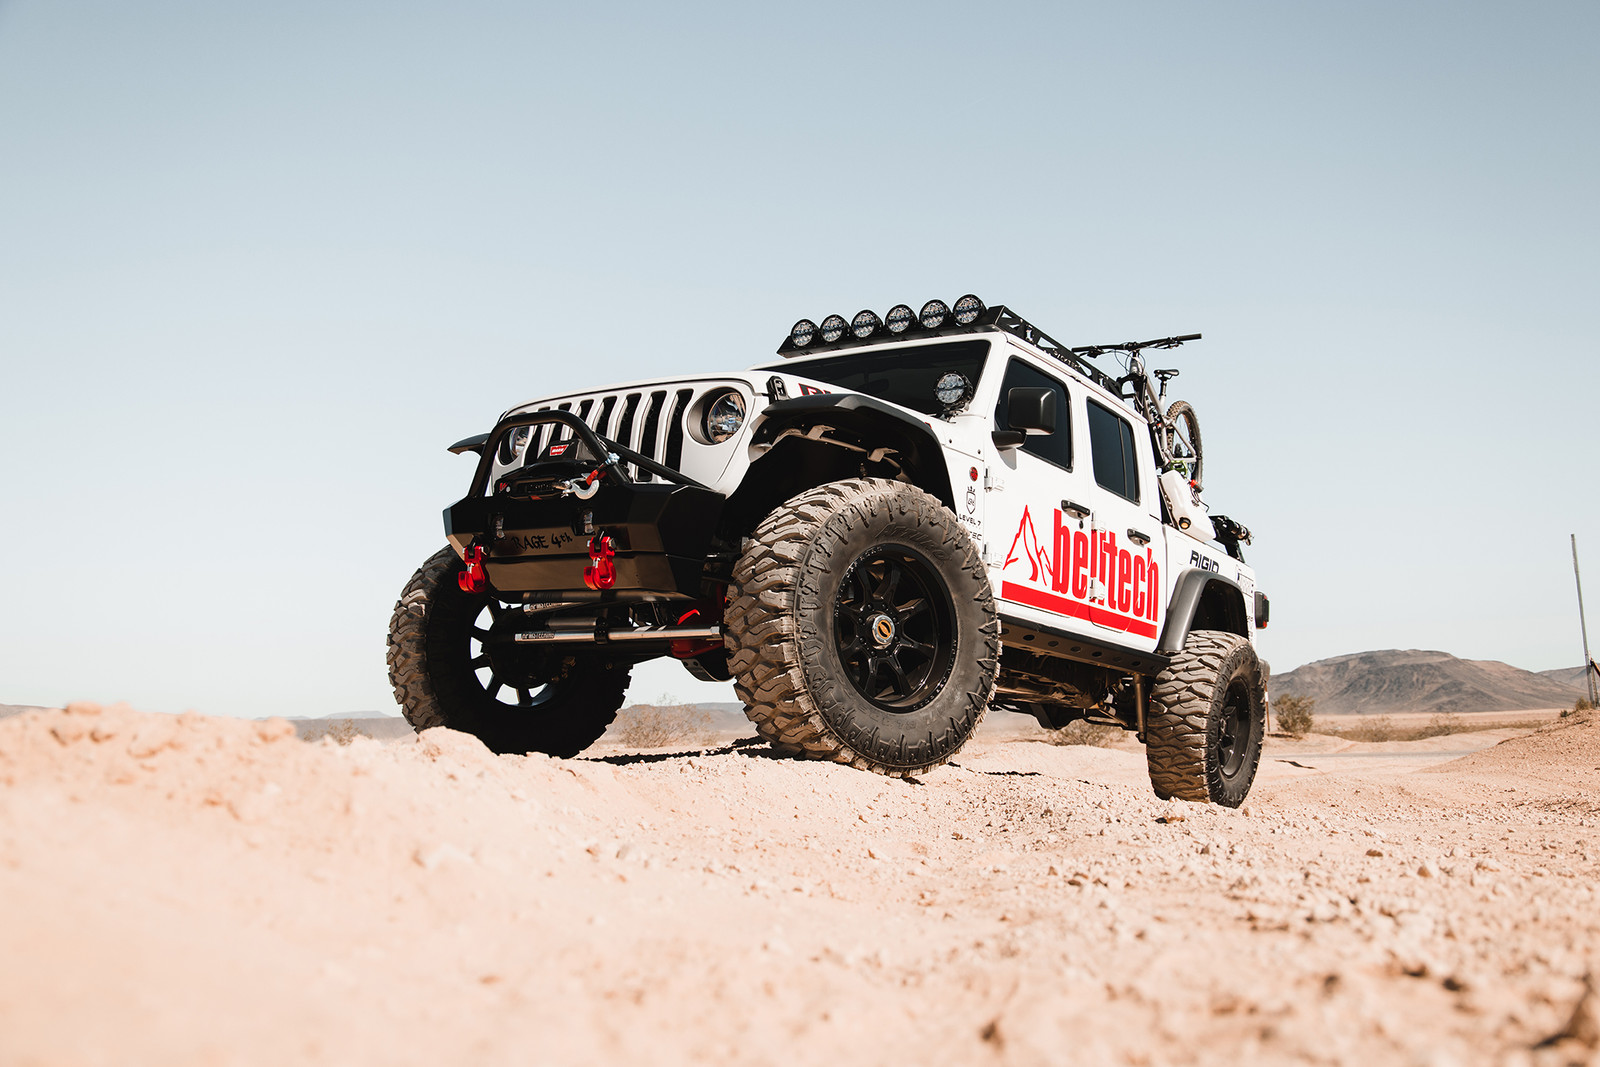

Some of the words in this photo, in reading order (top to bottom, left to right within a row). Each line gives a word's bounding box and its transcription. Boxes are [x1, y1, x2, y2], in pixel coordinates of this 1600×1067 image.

[959, 513, 977, 526] LEVEL
[1051, 508, 1159, 622] belltech
[1190, 550, 1219, 574] RIGID
